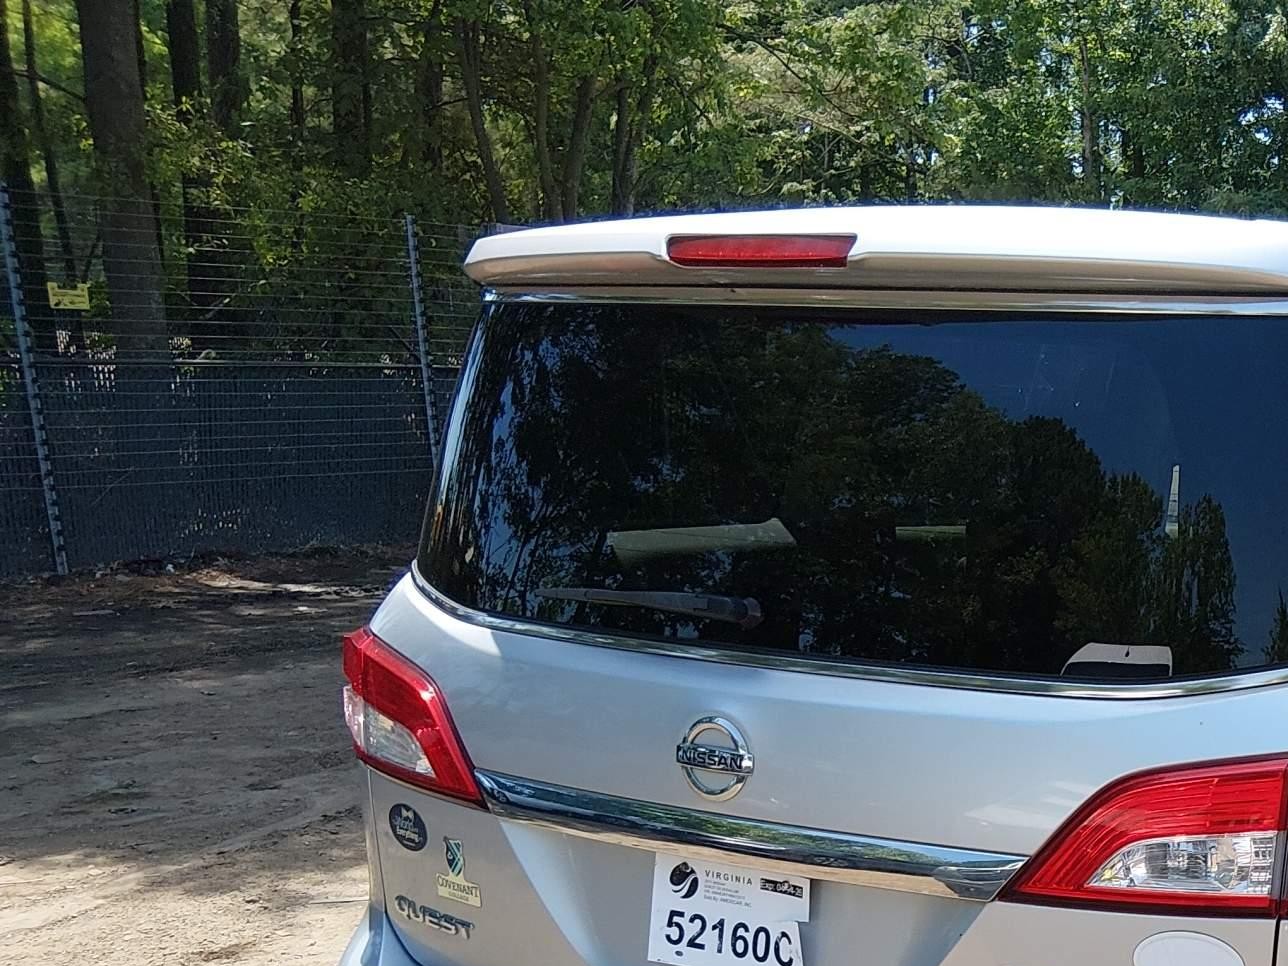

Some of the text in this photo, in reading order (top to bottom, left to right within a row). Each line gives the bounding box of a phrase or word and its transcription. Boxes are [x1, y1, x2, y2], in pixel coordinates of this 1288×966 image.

[681, 747, 744, 769] NISSAN
[704, 869, 753, 886] VIRGINIA
[395, 894, 475, 940] QUEST
